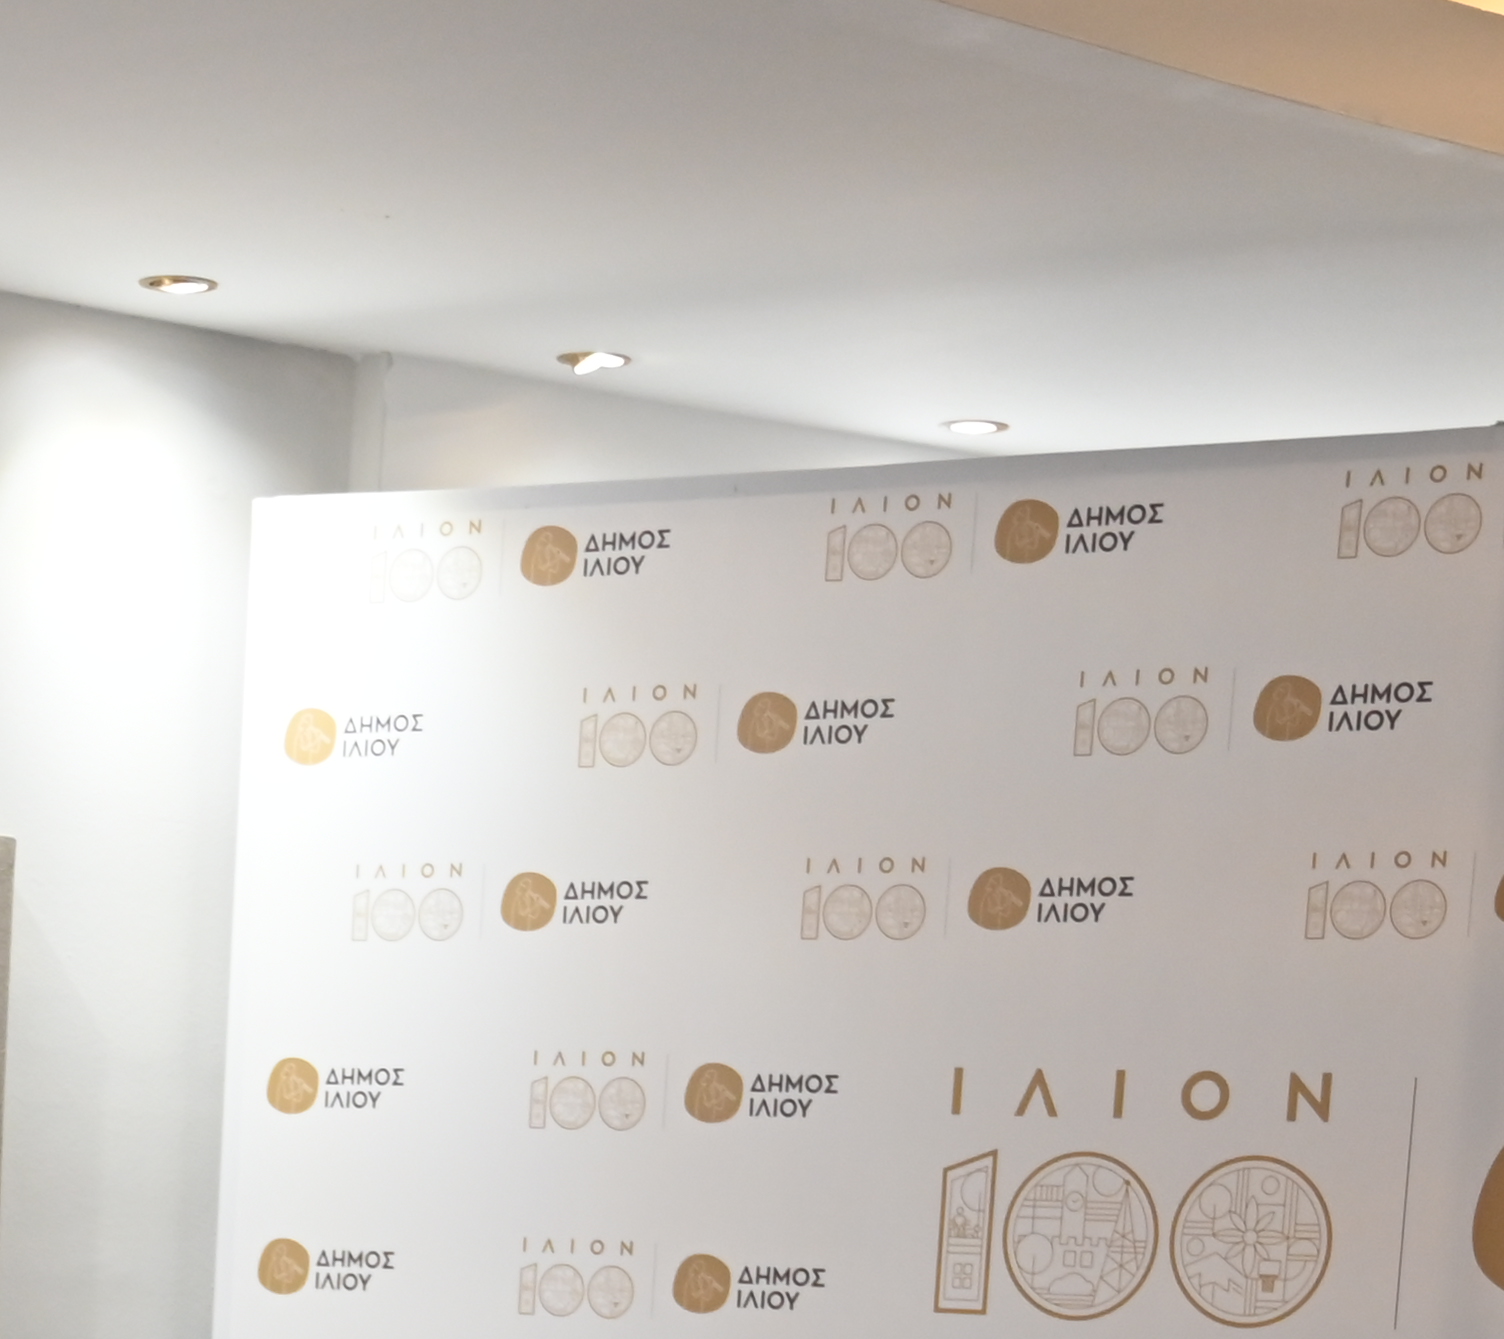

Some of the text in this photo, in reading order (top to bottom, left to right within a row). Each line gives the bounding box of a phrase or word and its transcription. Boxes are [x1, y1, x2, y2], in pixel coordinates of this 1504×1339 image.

[1345, 462, 1484, 488] ΙΛΙΟΝ
[830, 492, 953, 515] ΙΛΙΟΝ
[1066, 503, 1164, 528] ΔΗΜΟΣ
[584, 529, 671, 553] ΔΗΜΟΣ
[1065, 530, 1135, 554] ΙΛΙΟΥ
[583, 555, 645, 577] ΙΛΙΟΥ
[1080, 666, 1209, 688] ΙΛΙΟΝ
[582, 683, 698, 704] ΙΛΙΟΝ
[1330, 681, 1433, 705] ΔΗΜΟΣ
[804, 698, 895, 720] ΔΗΜΟΣ
[344, 713, 423, 734] ΔΗΜΟΣ
[1328, 709, 1402, 732] ΙΛΙΟΥ
[803, 724, 868, 745] ΙΛΙΟΥ
[341, 739, 399, 757] ΙΛΙΟΥ
[356, 862, 464, 879] ΙΛΙΟΝ
[806, 856, 927, 874] ΙΛΙΟΝ
[1311, 850, 1448, 870] ΙΛΙΟΝ
[564, 880, 649, 900] ΔΗΜΟΣ
[1038, 876, 1134, 897] ΔΗΜΟΣ
[563, 905, 623, 924] ΙΛΙΟΥ
[1037, 902, 1106, 923] ΙΛΙΟΥ
[533, 1050, 646, 1067] ΙΛΙΟΝ
[326, 1068, 404, 1086] ΔΗΜΟΣ
[750, 1074, 839, 1094] ΔΗΜΟΣ
[325, 1091, 381, 1109] ΙΛΙΟΥ
[950, 1066, 1334, 1123] ΙΛΙΟΝ
[749, 1098, 812, 1118] ΙΛΙΟΥ
[522, 1237, 635, 1256] ΙΛΙΟΝ
[933, 1148, 1334, 1329] 100
[316, 1250, 394, 1270] ΔΗΜΟΣ
[315, 1273, 371, 1291] ΙΛΙΟΥ
[738, 1266, 826, 1288] ΔΗΜΟΣ
[737, 1290, 799, 1310] ΙΛΙΟΥ
